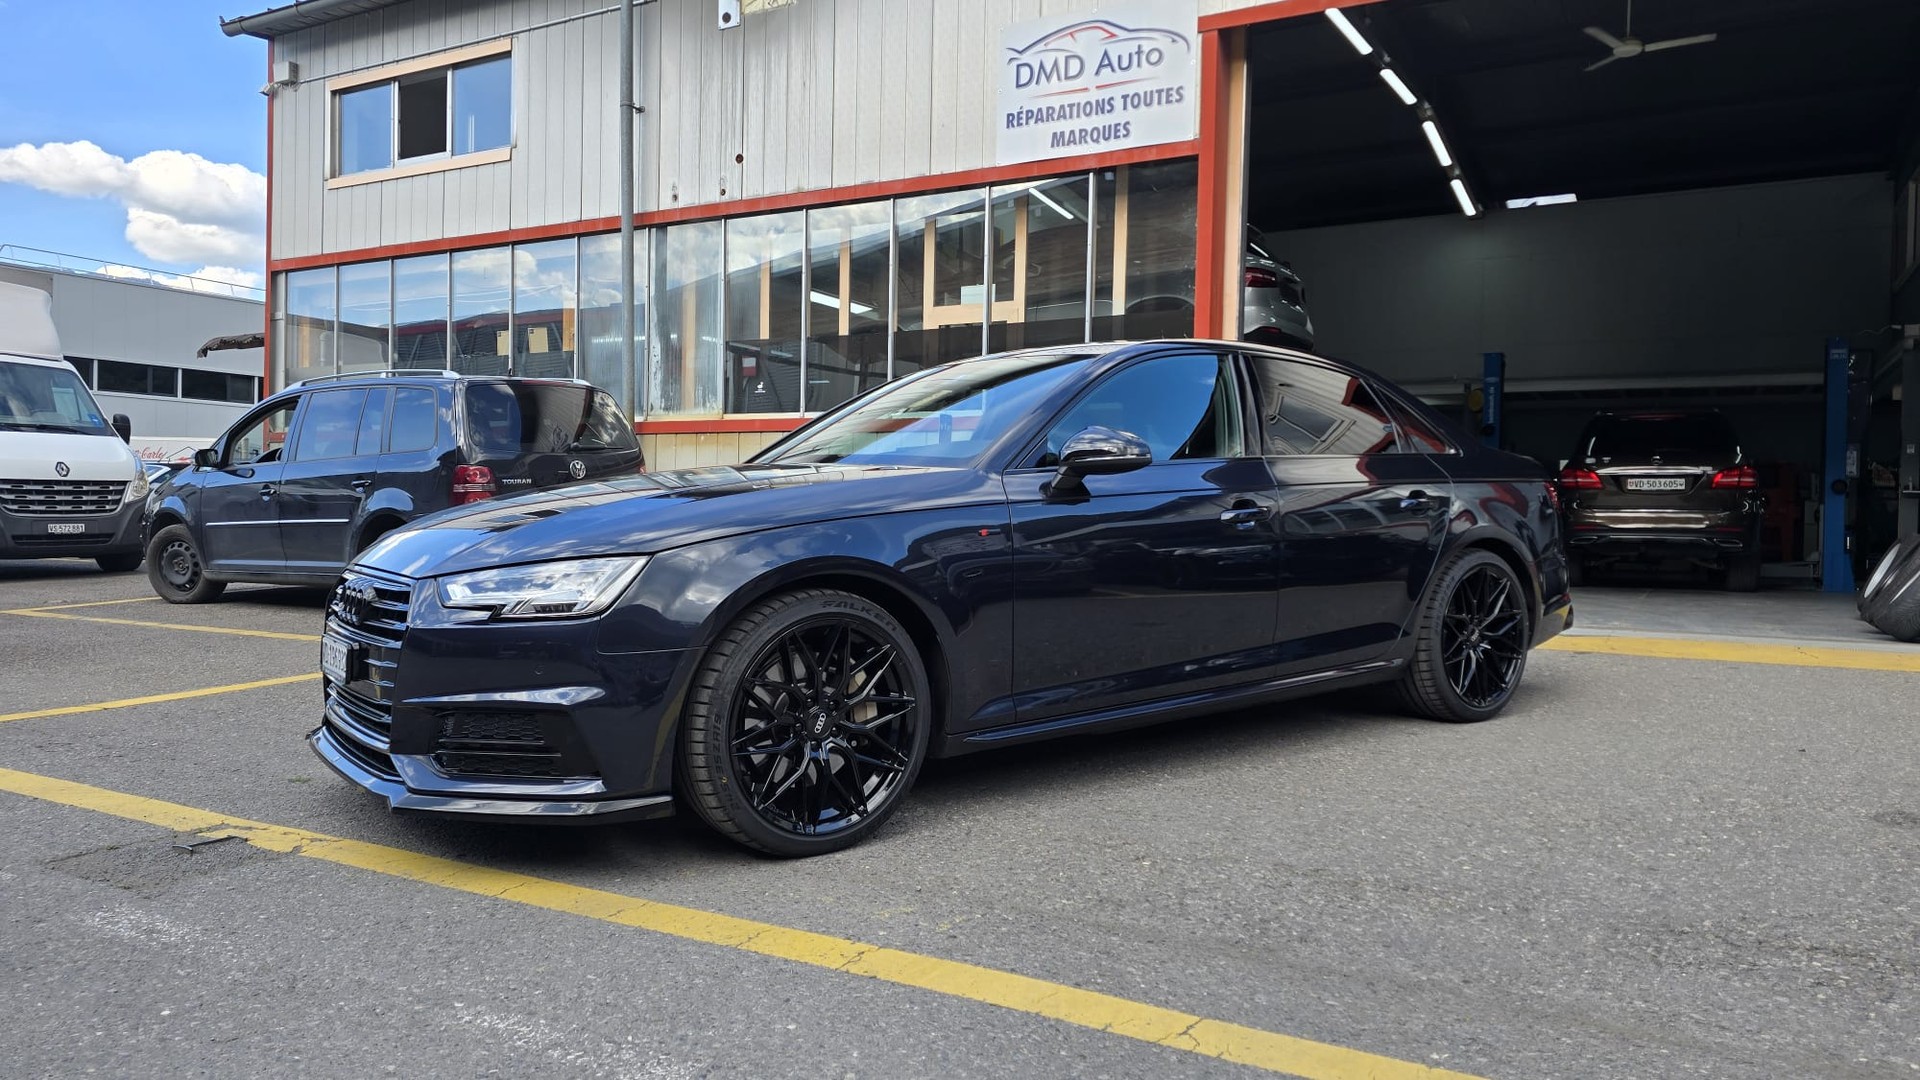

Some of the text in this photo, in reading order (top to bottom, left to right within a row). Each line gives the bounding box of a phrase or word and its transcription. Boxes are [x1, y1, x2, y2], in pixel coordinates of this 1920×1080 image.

[1015, 44, 1164, 89] DMD Auto
[1005, 85, 1185, 129] RÉPARATIONS TOUTES
[1050, 121, 1131, 148] MARQUES
[501, 477, 532, 485] TOURAN
